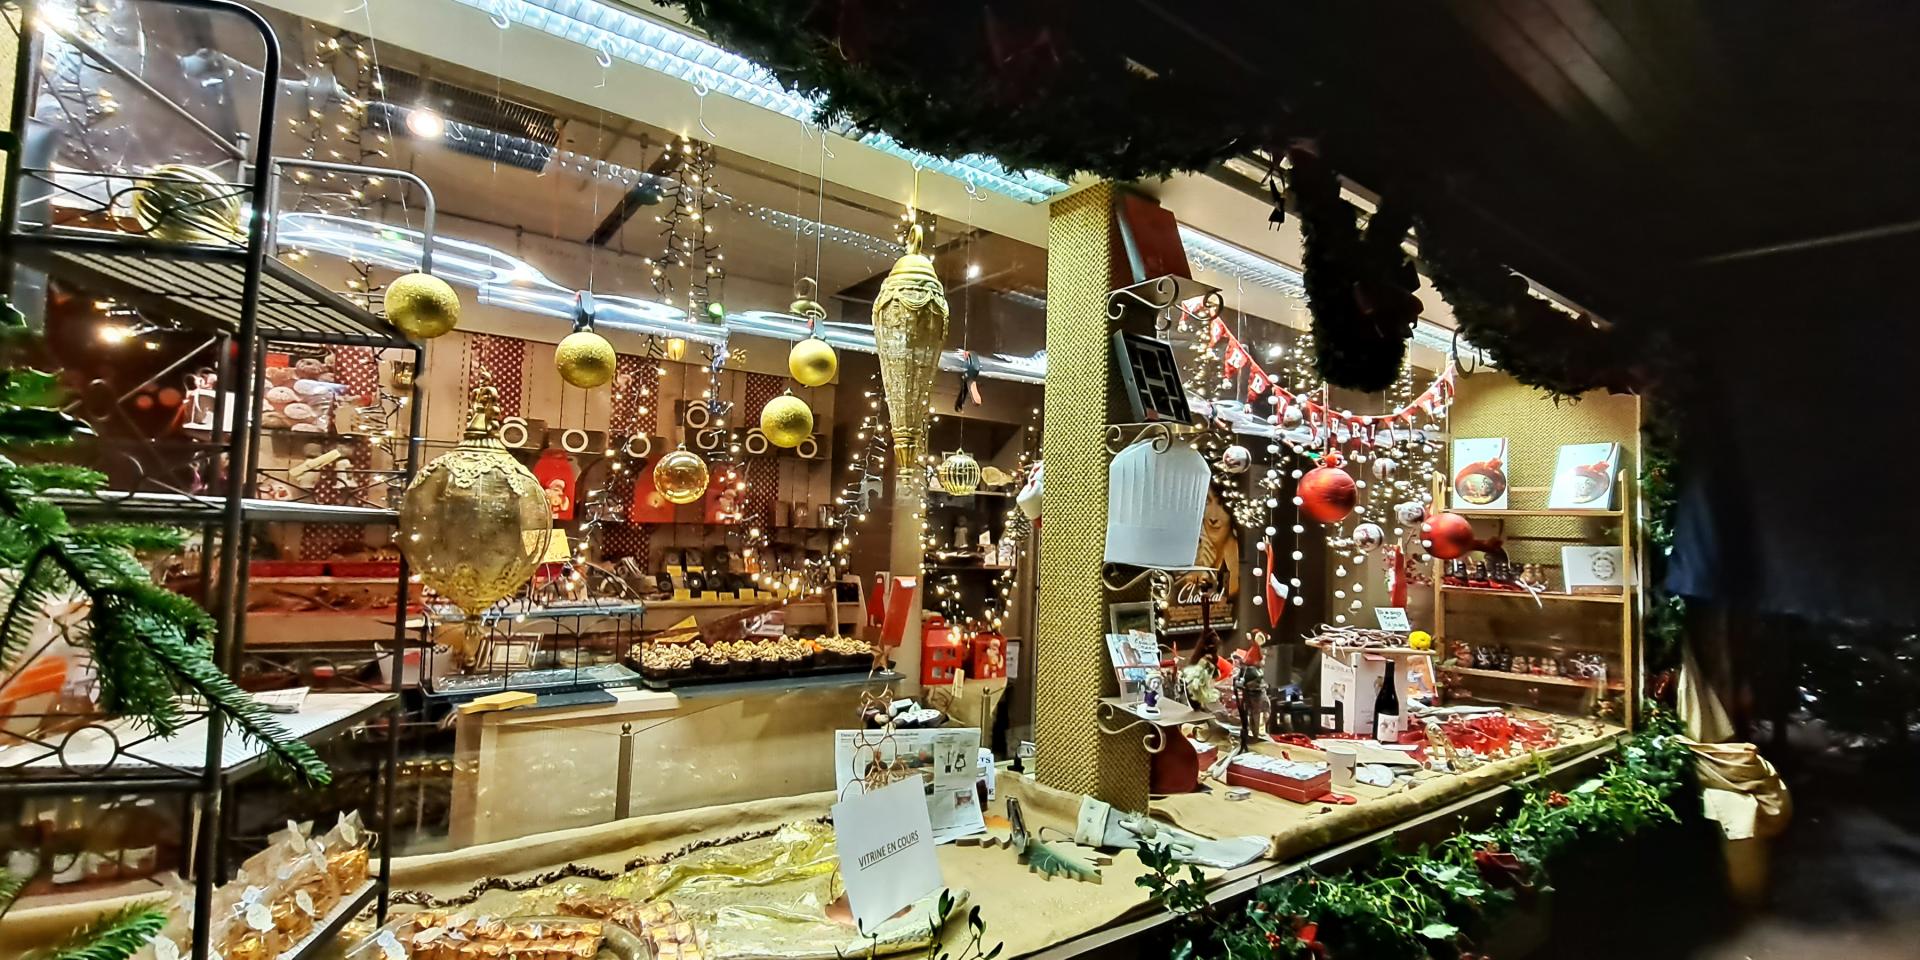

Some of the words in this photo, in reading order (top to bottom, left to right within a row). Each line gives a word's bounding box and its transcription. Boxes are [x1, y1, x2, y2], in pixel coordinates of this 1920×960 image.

[1178, 581, 1225, 604] Choat
[858, 846, 886, 867] VITRINE
[886, 841, 897, 854] EN
[897, 830, 919, 848] COURS
